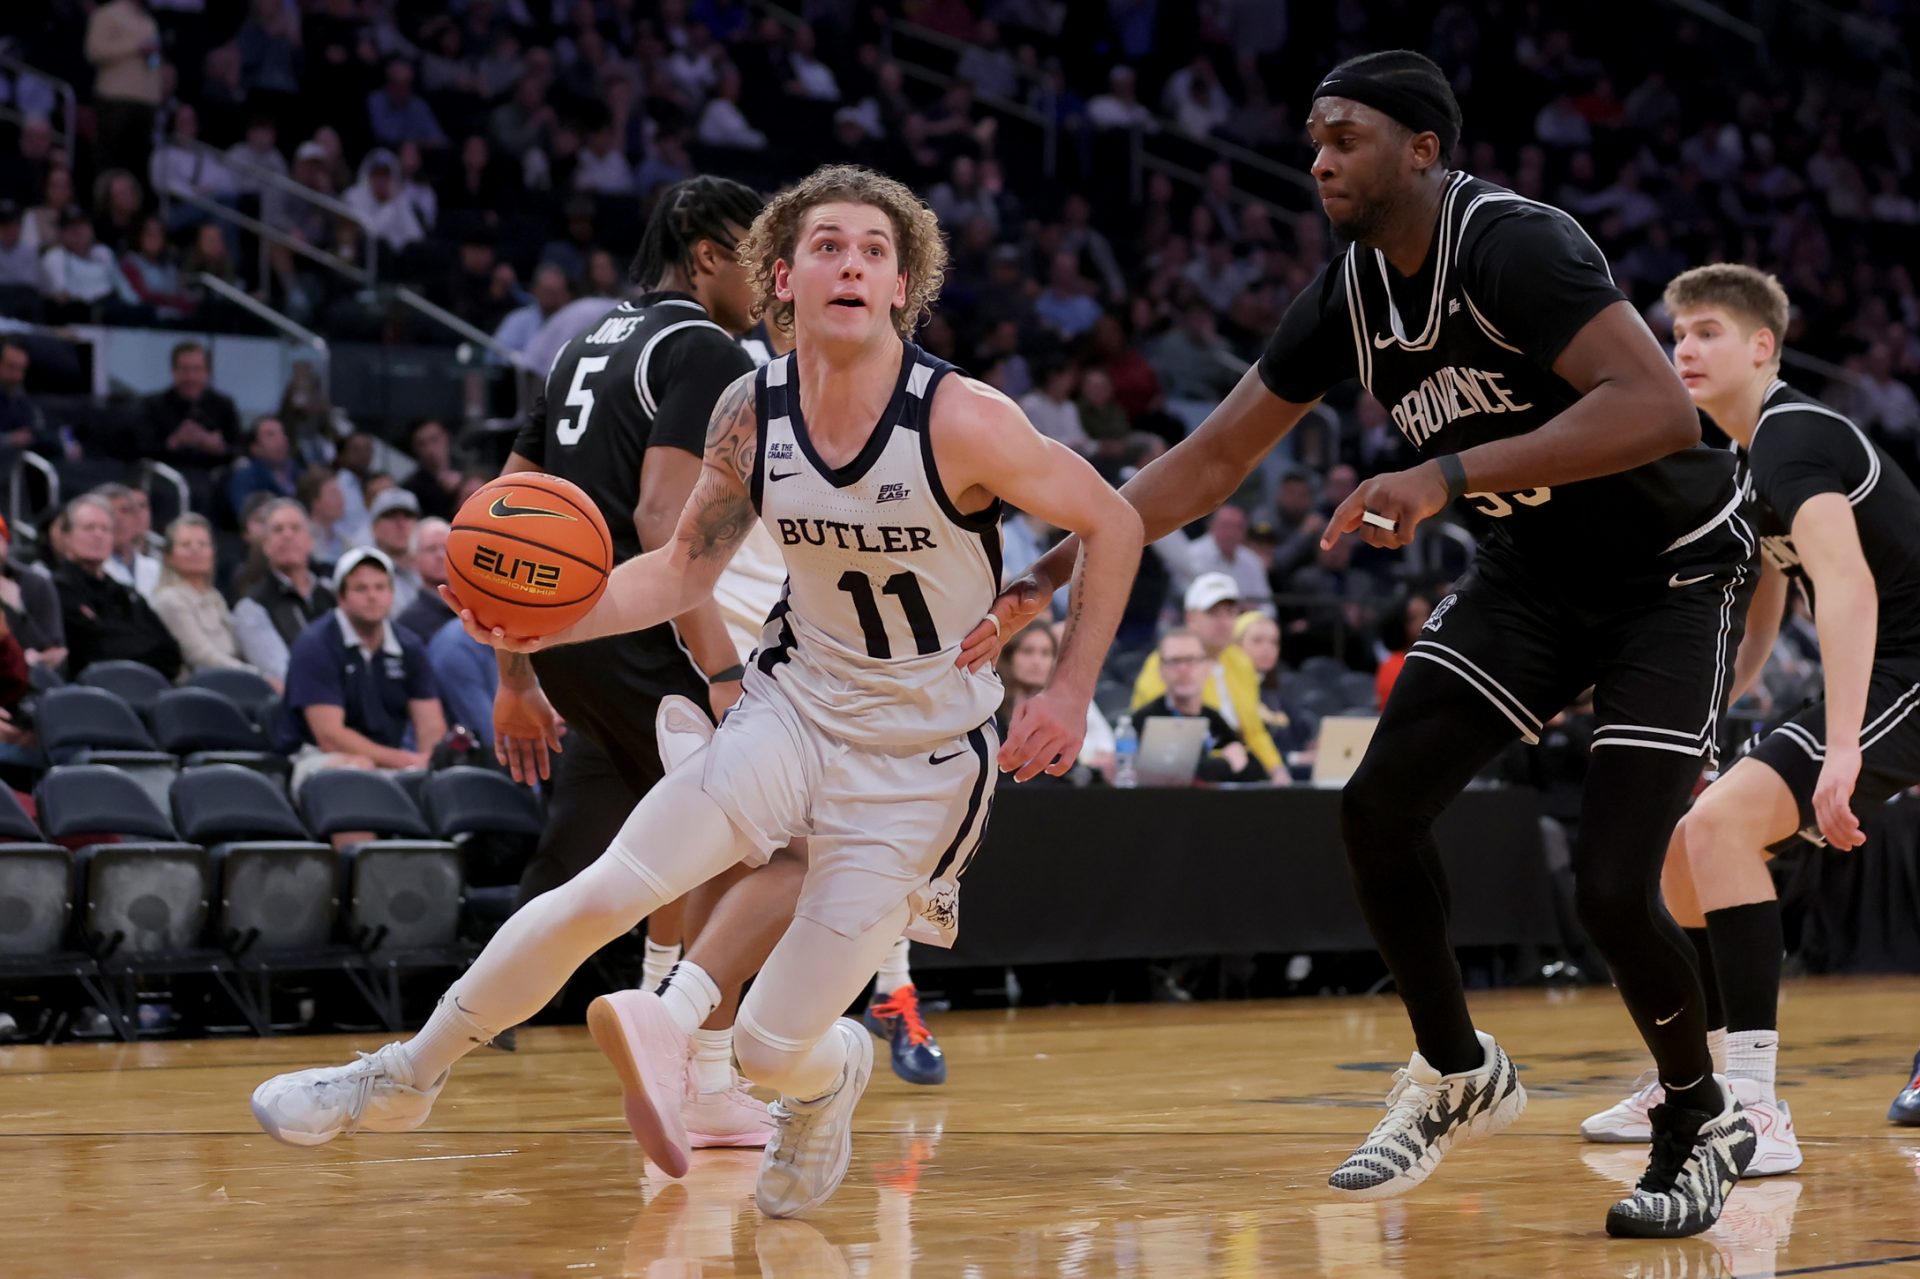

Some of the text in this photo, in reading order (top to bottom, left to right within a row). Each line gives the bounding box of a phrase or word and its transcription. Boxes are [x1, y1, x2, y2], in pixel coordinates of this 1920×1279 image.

[585, 315, 646, 345] JONES
[556, 355, 610, 446] 5
[767, 451, 794, 460] CHANGE
[770, 442, 794, 451] BE THE
[877, 490, 912, 500] EAST
[880, 483, 904, 493] BIG
[777, 518, 938, 553] BUTLER
[473, 544, 561, 589] ELITE
[837, 570, 942, 660] 11
